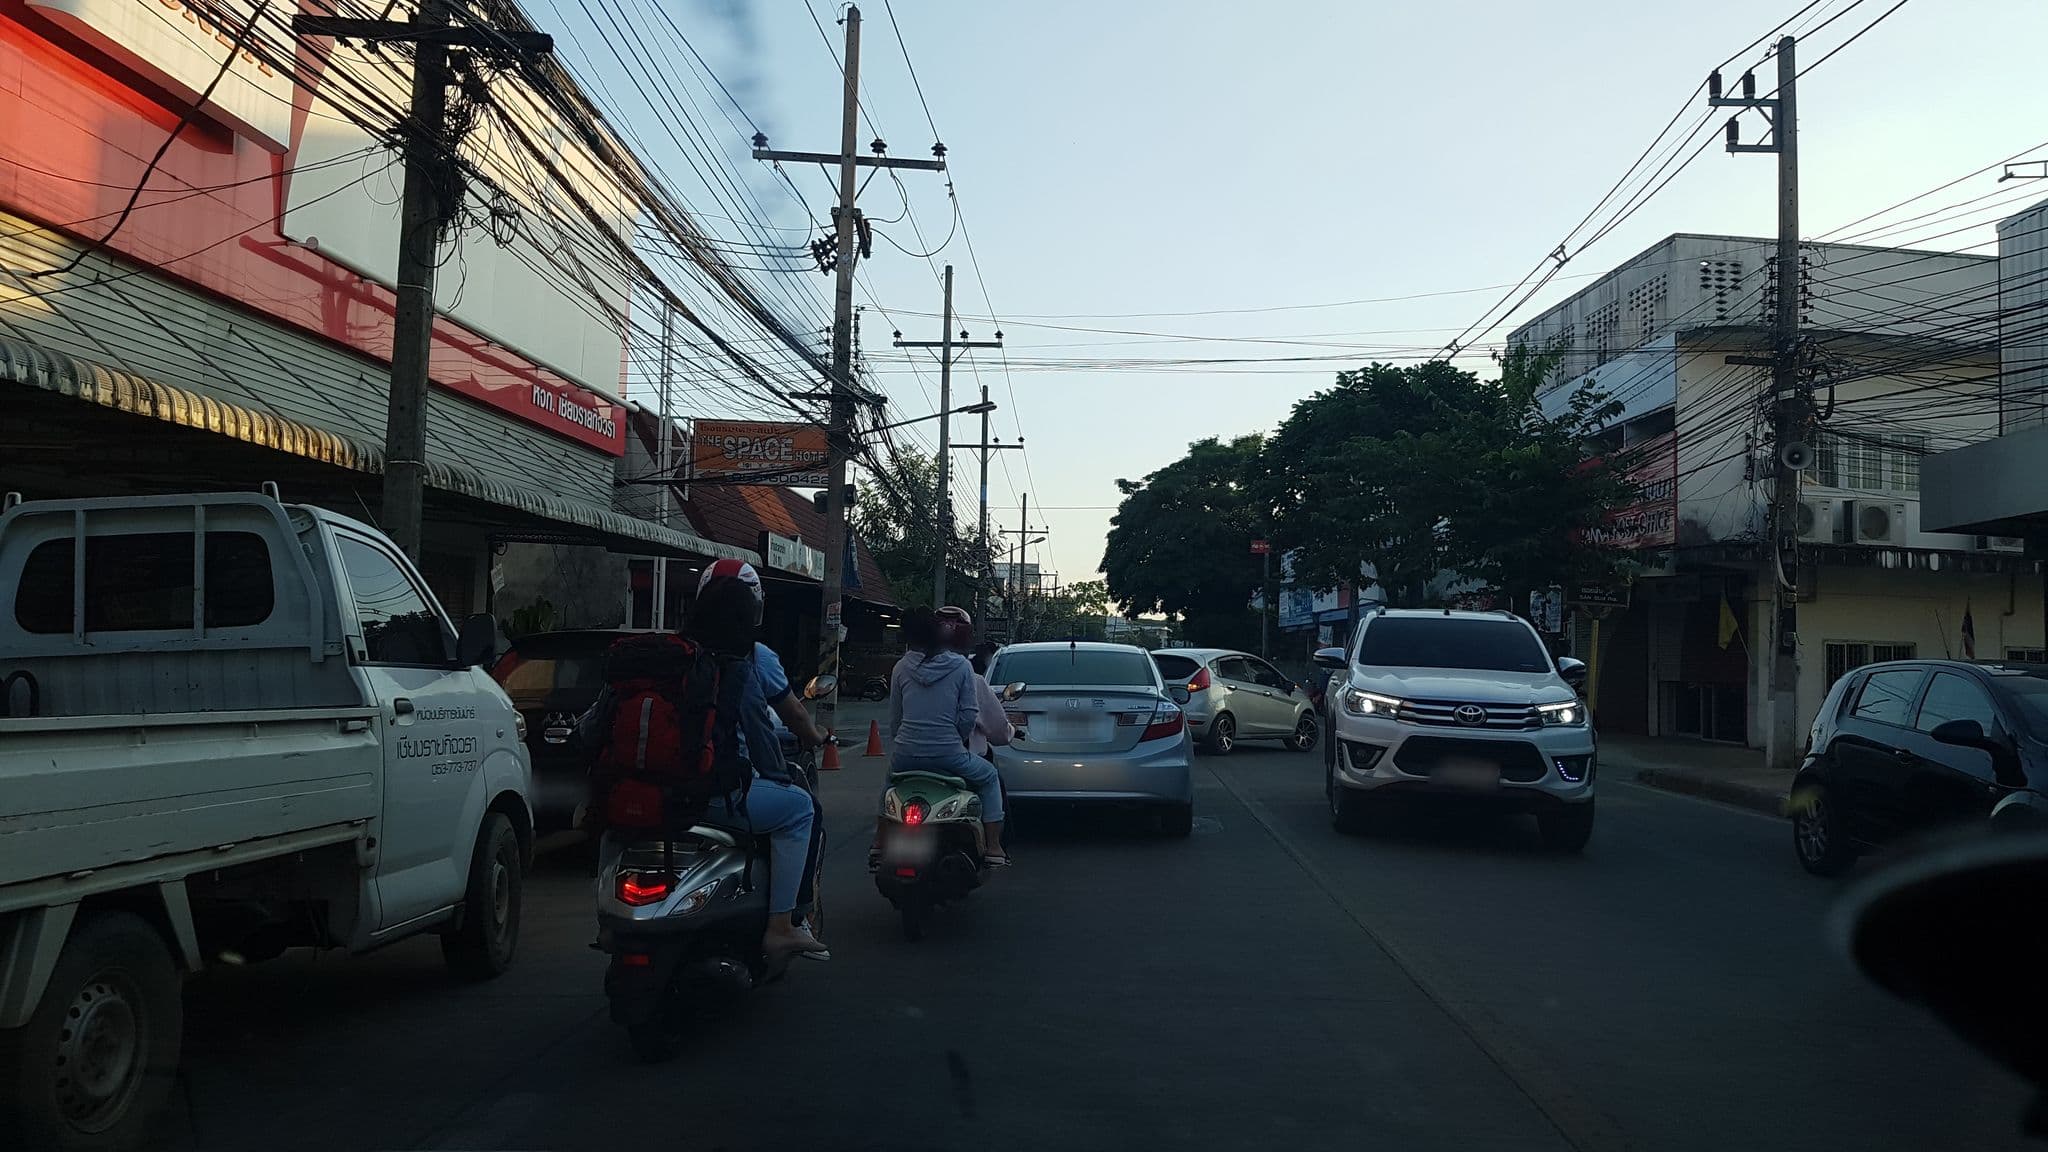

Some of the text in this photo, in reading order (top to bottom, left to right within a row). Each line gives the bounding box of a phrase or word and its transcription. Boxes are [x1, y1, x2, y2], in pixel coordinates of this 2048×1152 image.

[701, 434, 830, 462] THE SPACE HOTE
[396, 734, 477, 759] เชียงรายกิจวรา
[431, 759, 477, 776] 053-773-737
